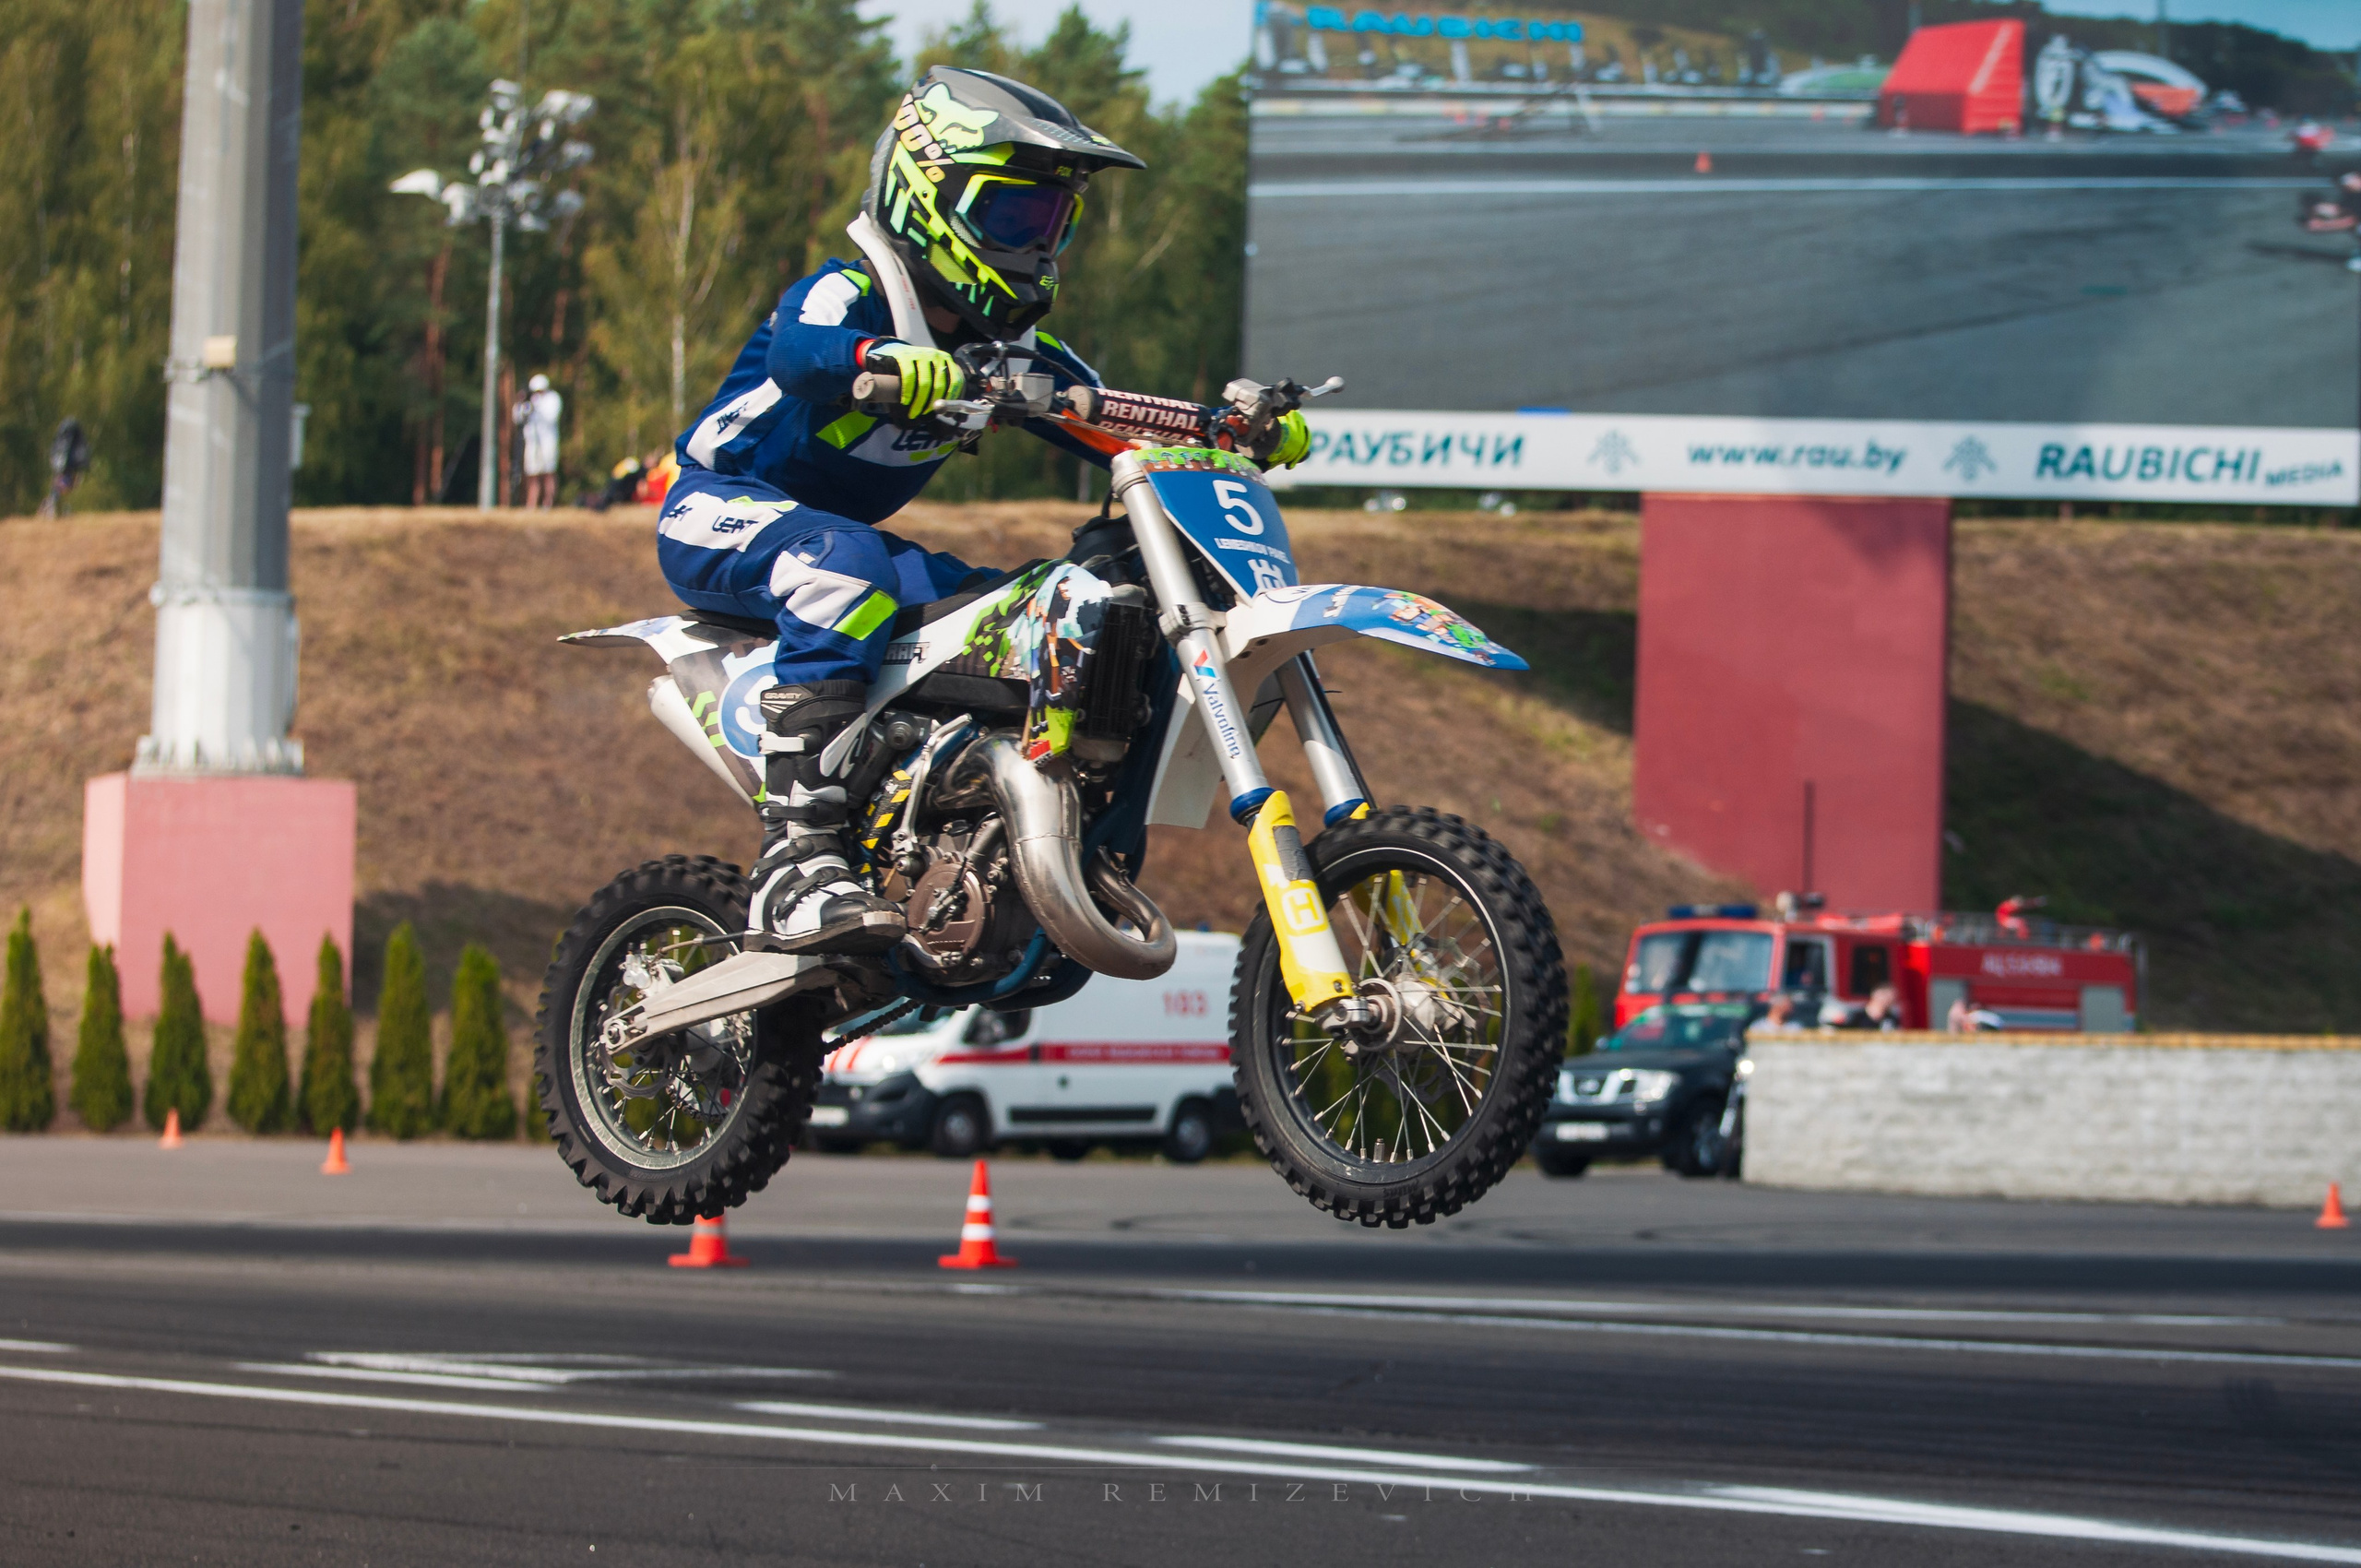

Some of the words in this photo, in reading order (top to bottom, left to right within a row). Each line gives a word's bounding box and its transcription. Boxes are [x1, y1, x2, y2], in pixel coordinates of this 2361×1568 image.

[1101, 399, 1201, 431] RENTHAL
[1306, 429, 1525, 467] РАУБИЧИ
[1687, 436, 1909, 476] www.rau.by
[2035, 443, 2262, 482] RAUBICHI
[1212, 479, 1264, 536] 5
[1203, 683, 1241, 757] Valvoline
